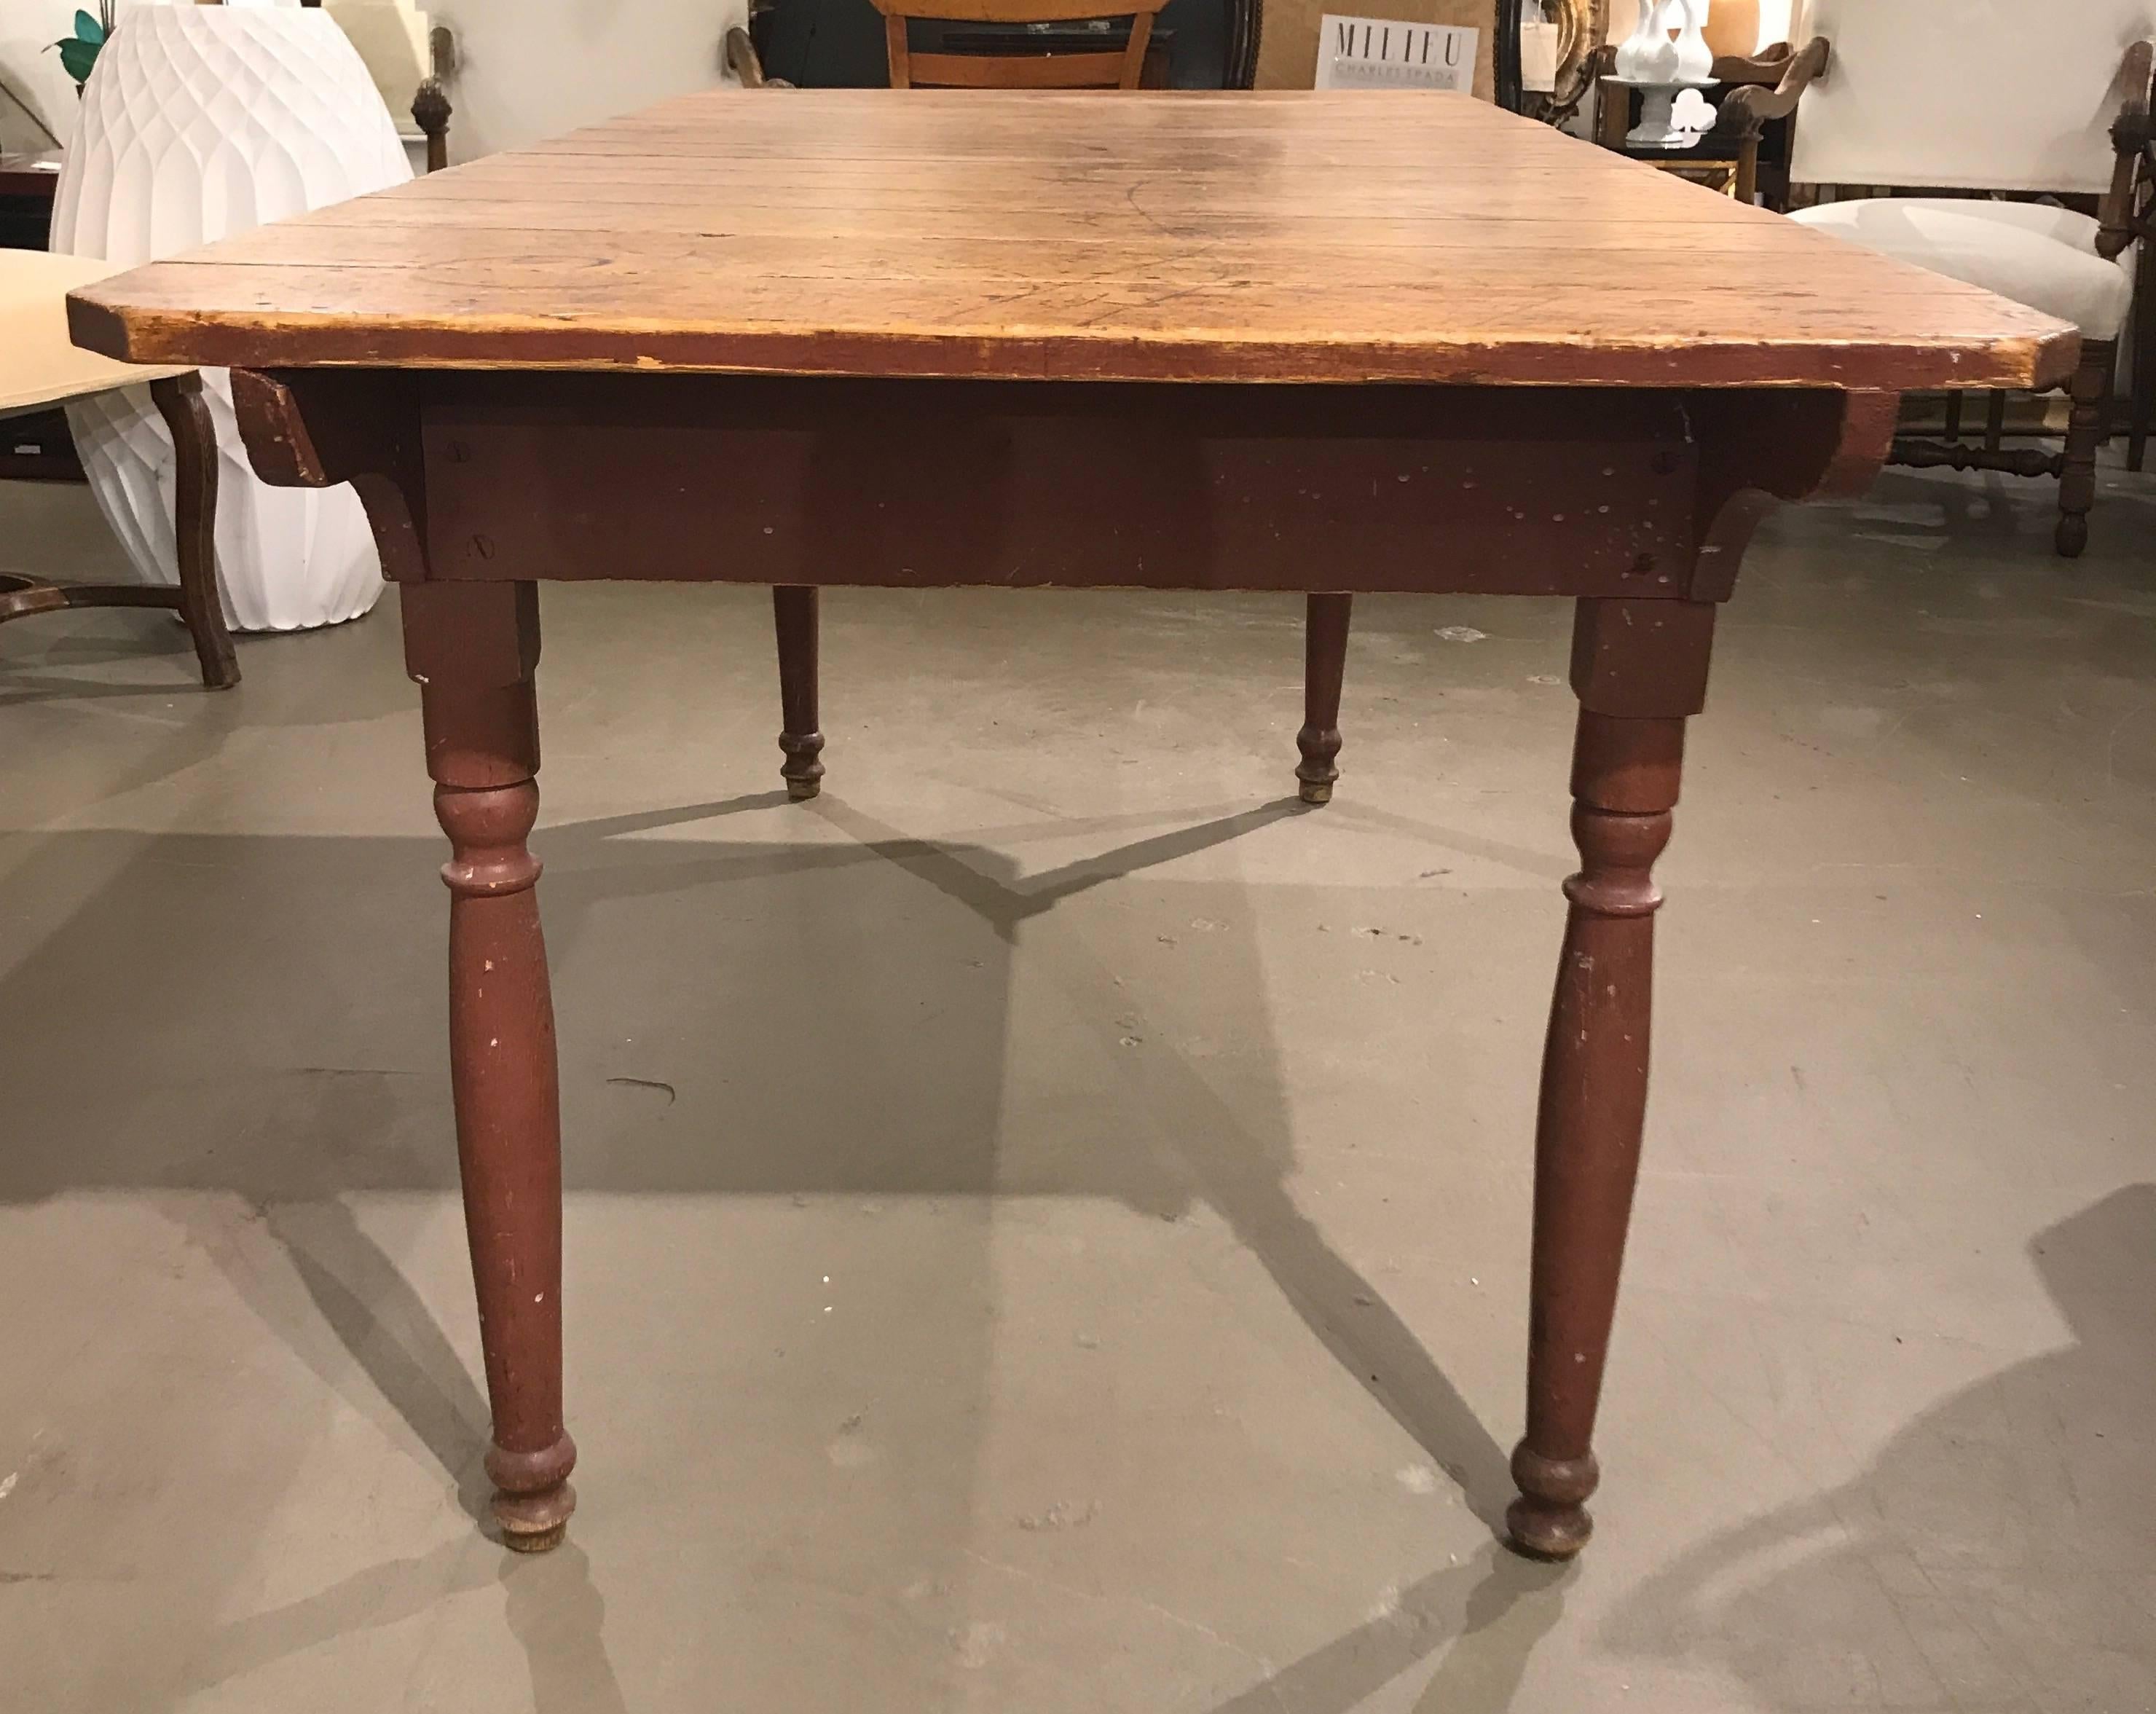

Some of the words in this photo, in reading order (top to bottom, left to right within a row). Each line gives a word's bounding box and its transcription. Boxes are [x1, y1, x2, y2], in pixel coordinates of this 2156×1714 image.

[1335, 23, 1463, 67] MILIEU
[1335, 63, 1401, 78] CHARLES
[1406, 69, 1455, 82] SPADA
